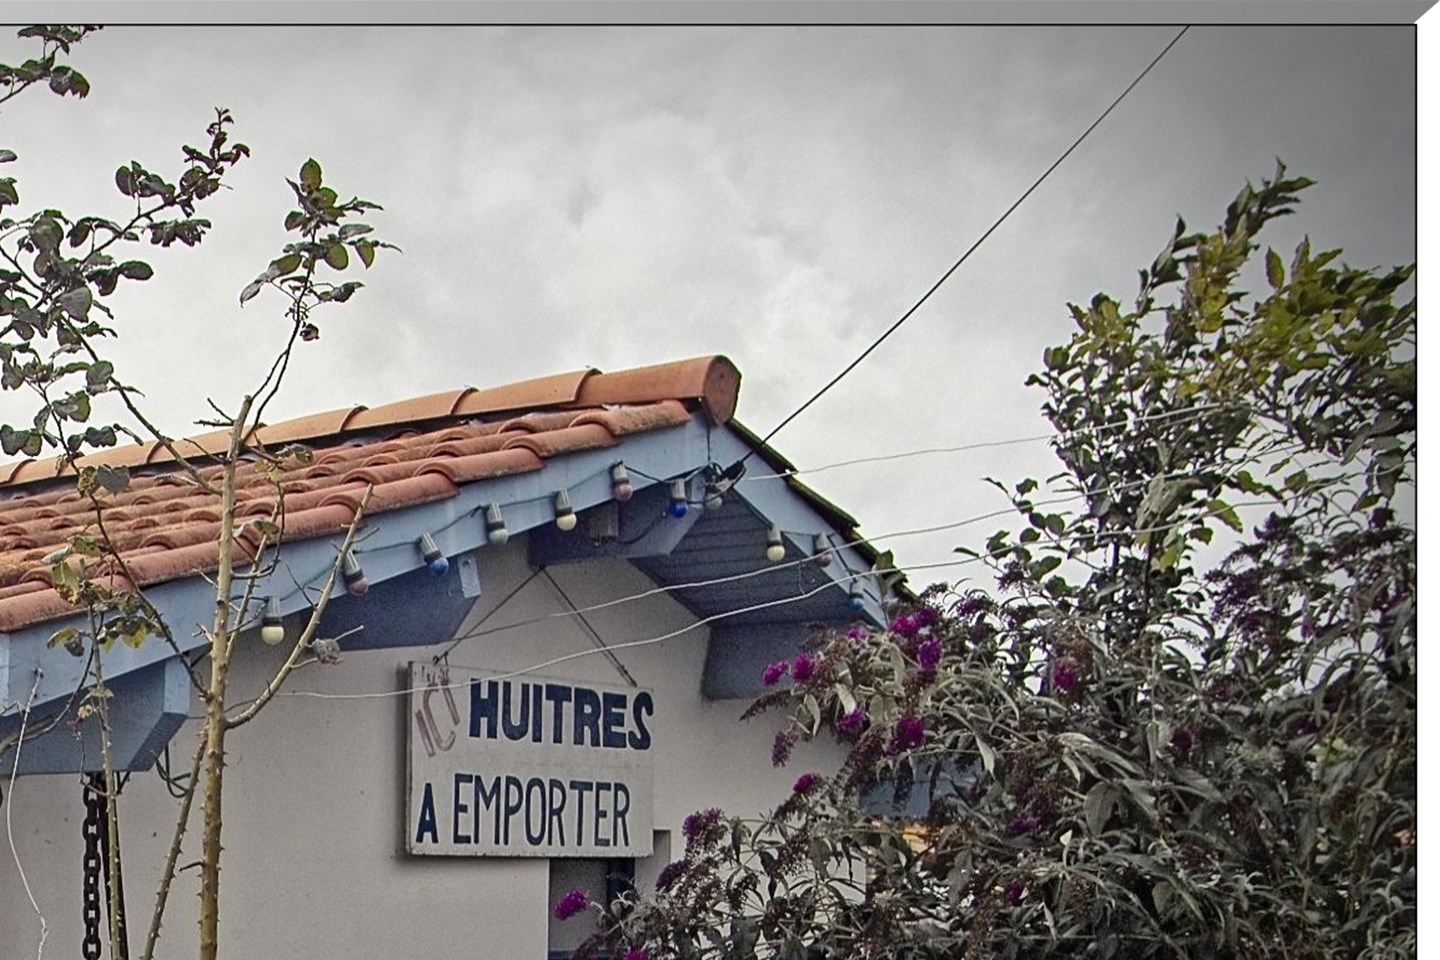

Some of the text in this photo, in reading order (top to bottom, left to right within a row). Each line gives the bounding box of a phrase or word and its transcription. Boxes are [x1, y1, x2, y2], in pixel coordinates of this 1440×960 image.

[469, 678, 654, 751] HUITRES
[415, 773, 631, 847] A EMPORTER
